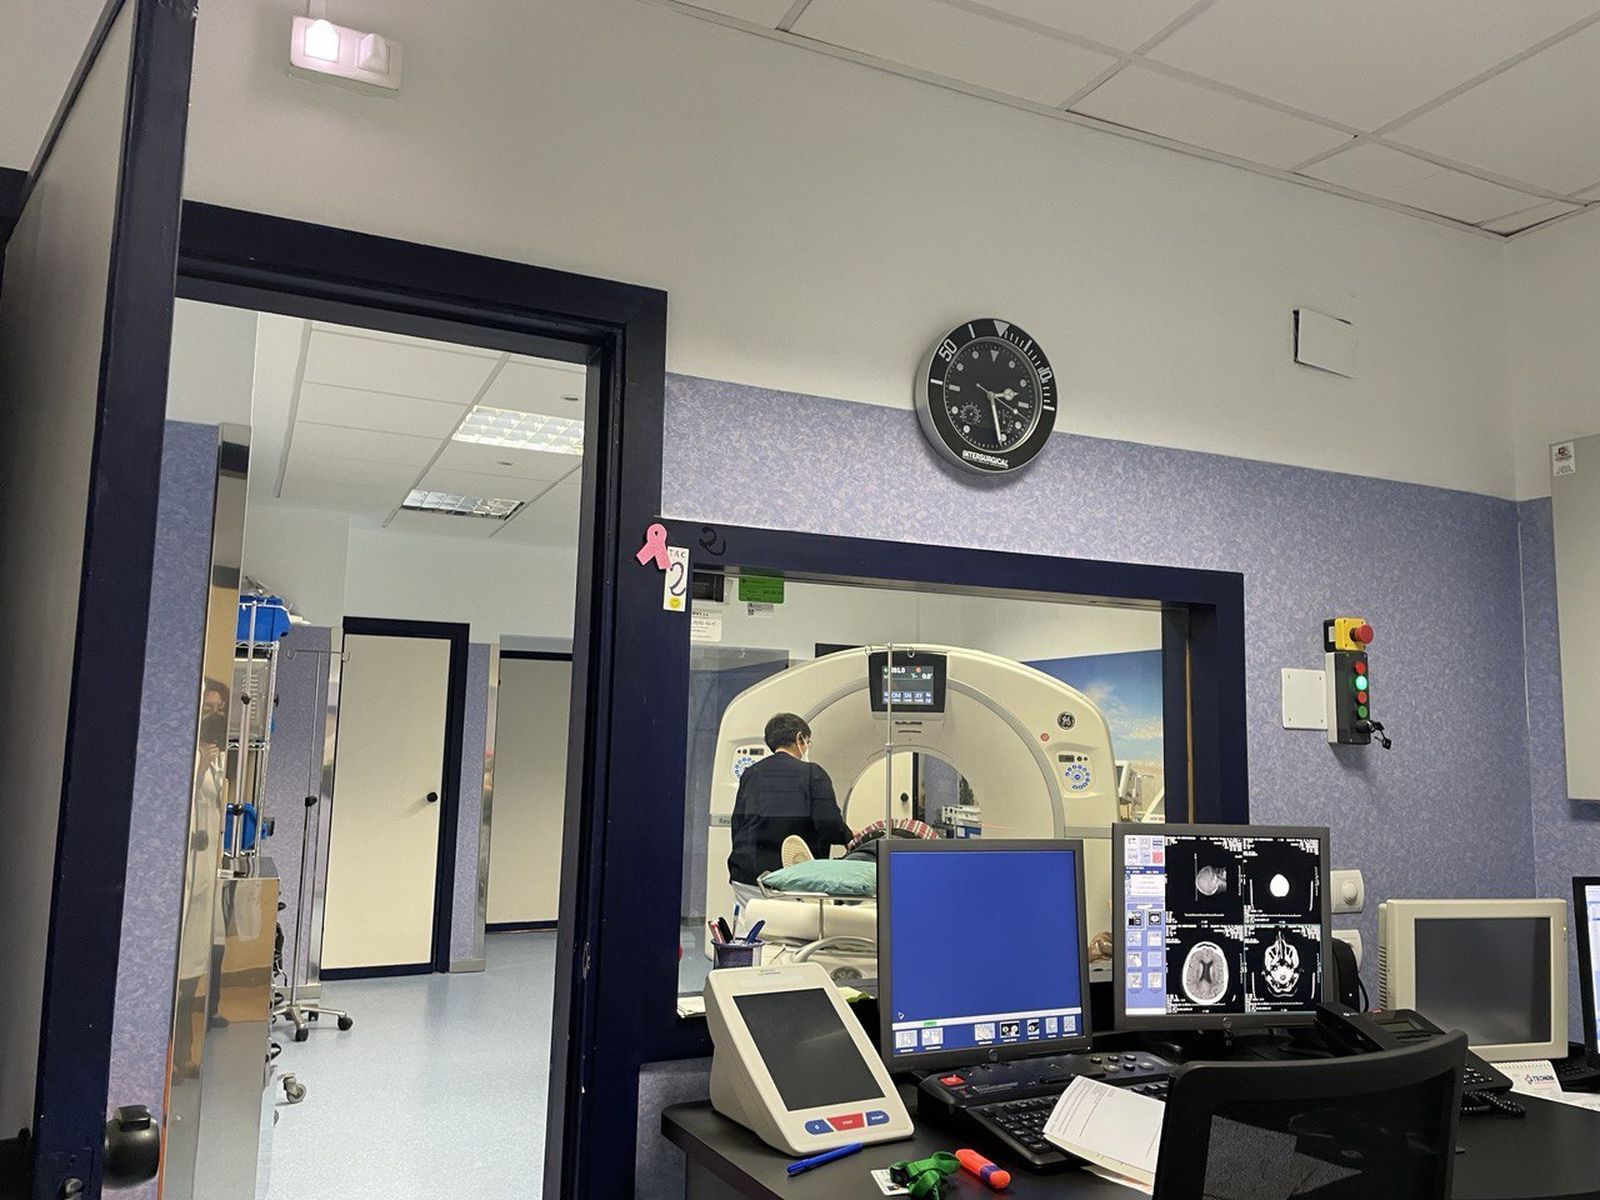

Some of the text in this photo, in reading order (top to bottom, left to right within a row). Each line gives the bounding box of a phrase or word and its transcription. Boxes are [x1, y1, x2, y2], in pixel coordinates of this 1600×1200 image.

[938, 339, 957, 361] 50
[1039, 367, 1052, 380] 10
[962, 450, 1008, 468] INTERSURGICAL
[669, 549, 686, 559] TAC
[670, 561, 686, 596] 2
